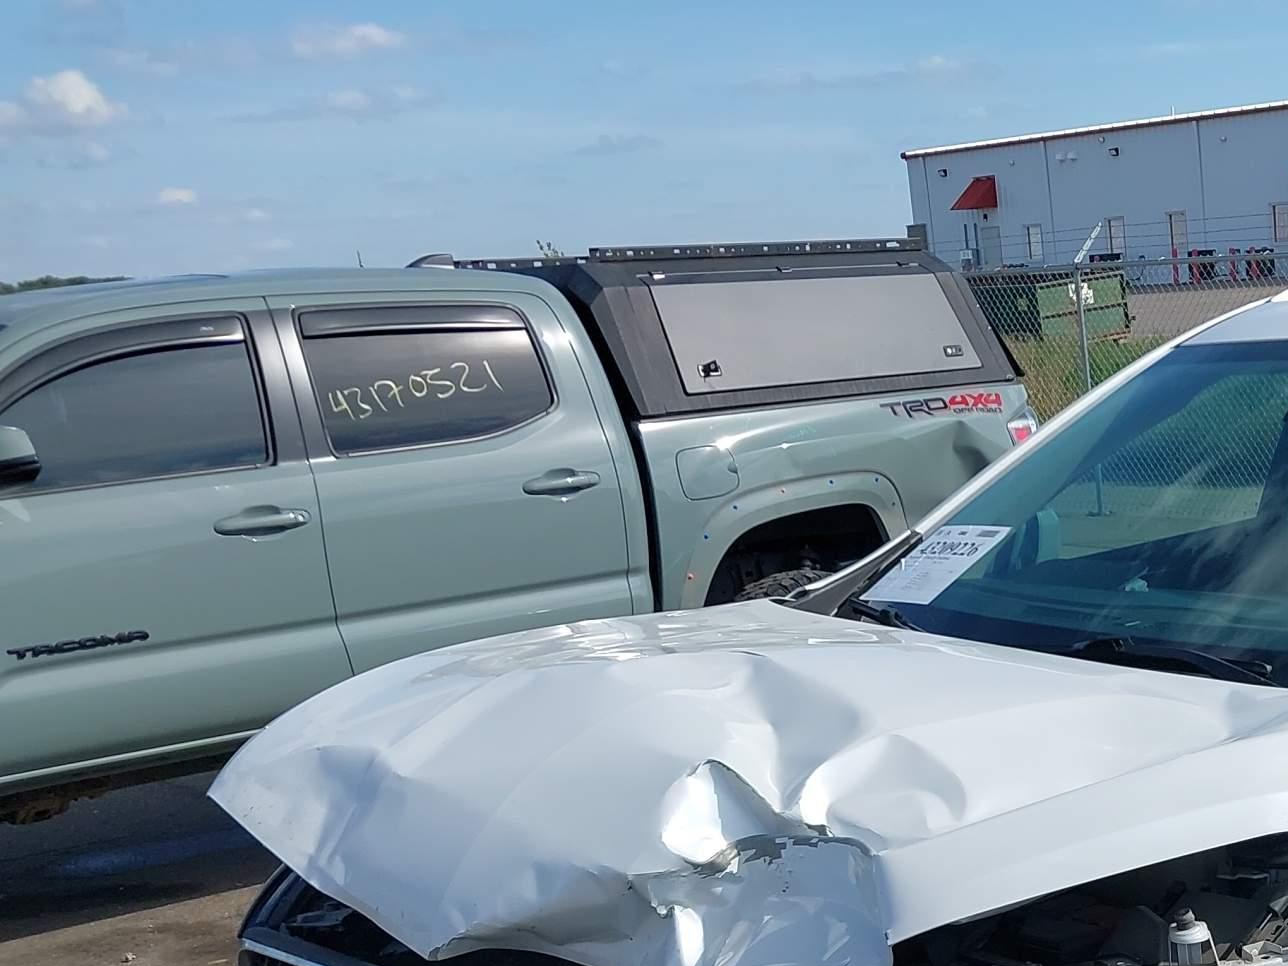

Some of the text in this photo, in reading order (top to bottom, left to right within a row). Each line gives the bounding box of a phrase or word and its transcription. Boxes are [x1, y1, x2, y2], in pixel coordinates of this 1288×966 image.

[328, 360, 504, 421] 43170521
[880, 397, 948, 418] TRD
[6, 630, 150, 660] TACOMA
